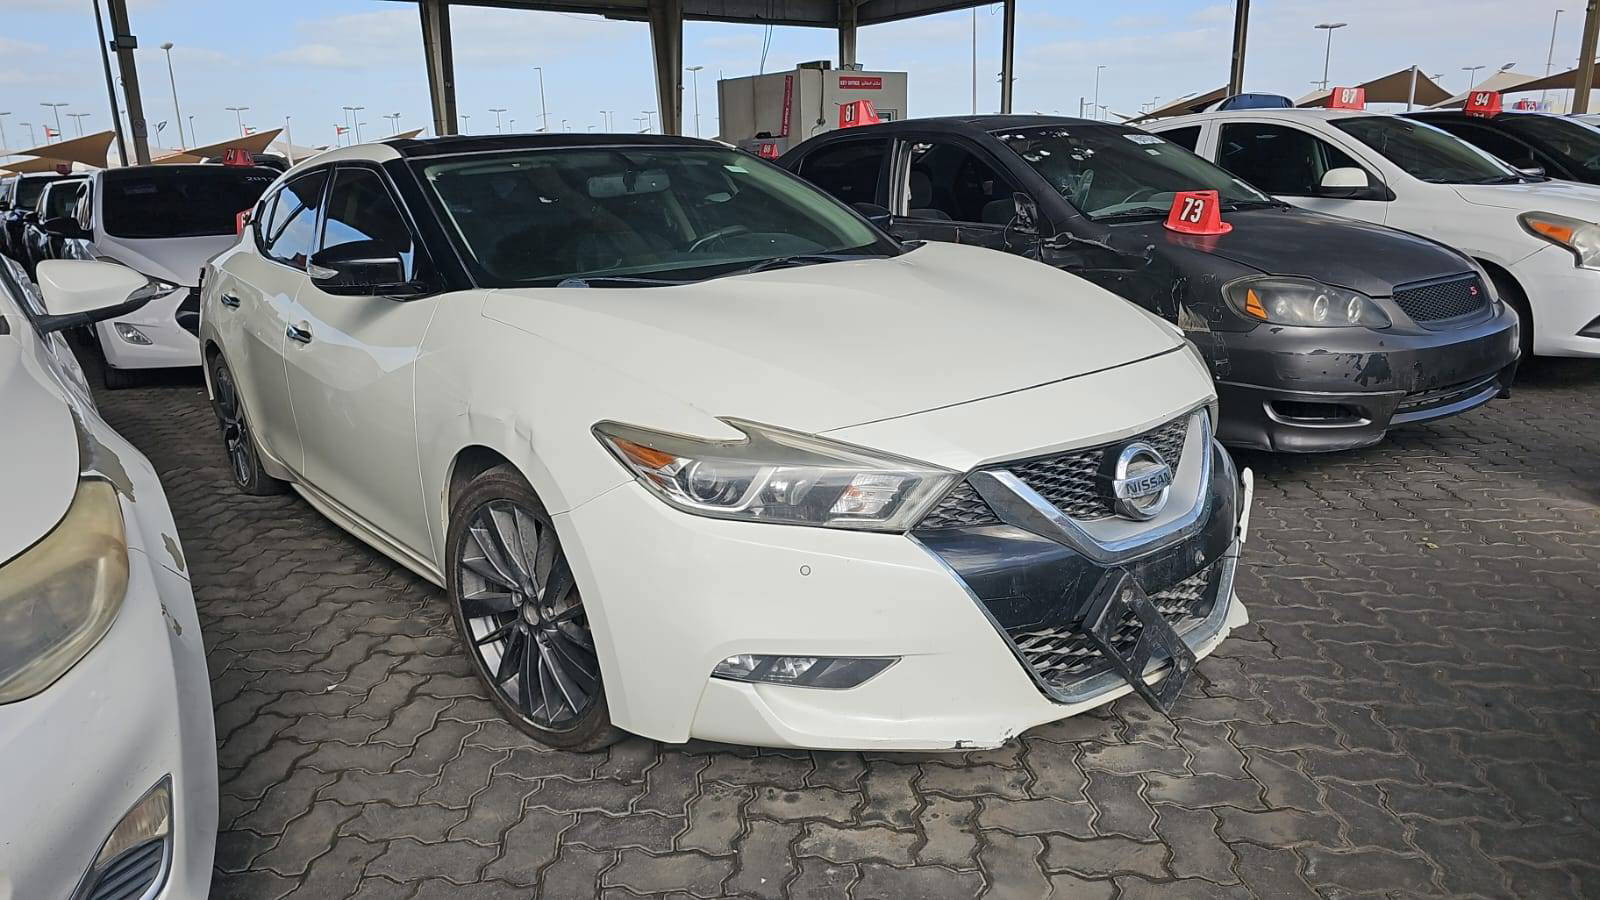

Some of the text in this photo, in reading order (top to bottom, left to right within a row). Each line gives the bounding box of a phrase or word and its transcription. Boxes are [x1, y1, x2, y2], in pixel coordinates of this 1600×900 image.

[1341, 88, 1358, 104] 87
[1474, 92, 1490, 106] 94
[845, 103, 855, 122] 81
[1180, 197, 1204, 223] 73
[1470, 286, 1478, 296] S
[1126, 471, 1171, 495] NISSAN
